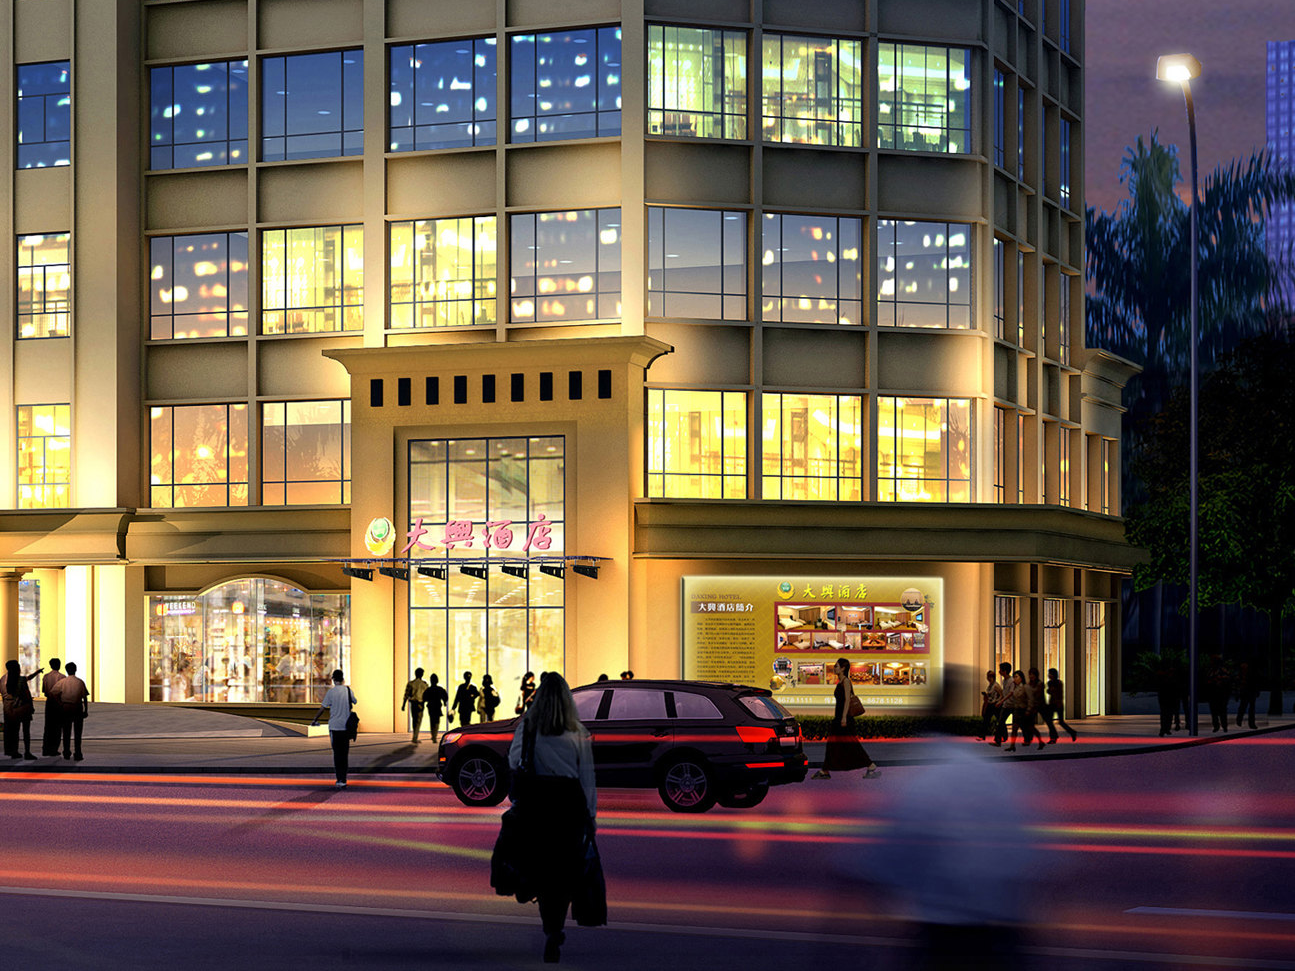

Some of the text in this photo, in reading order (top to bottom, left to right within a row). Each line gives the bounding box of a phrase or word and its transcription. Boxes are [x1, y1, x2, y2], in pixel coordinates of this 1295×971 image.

[401, 513, 553, 554] 大興酒店
[802, 583, 869, 600] 大興酒店
